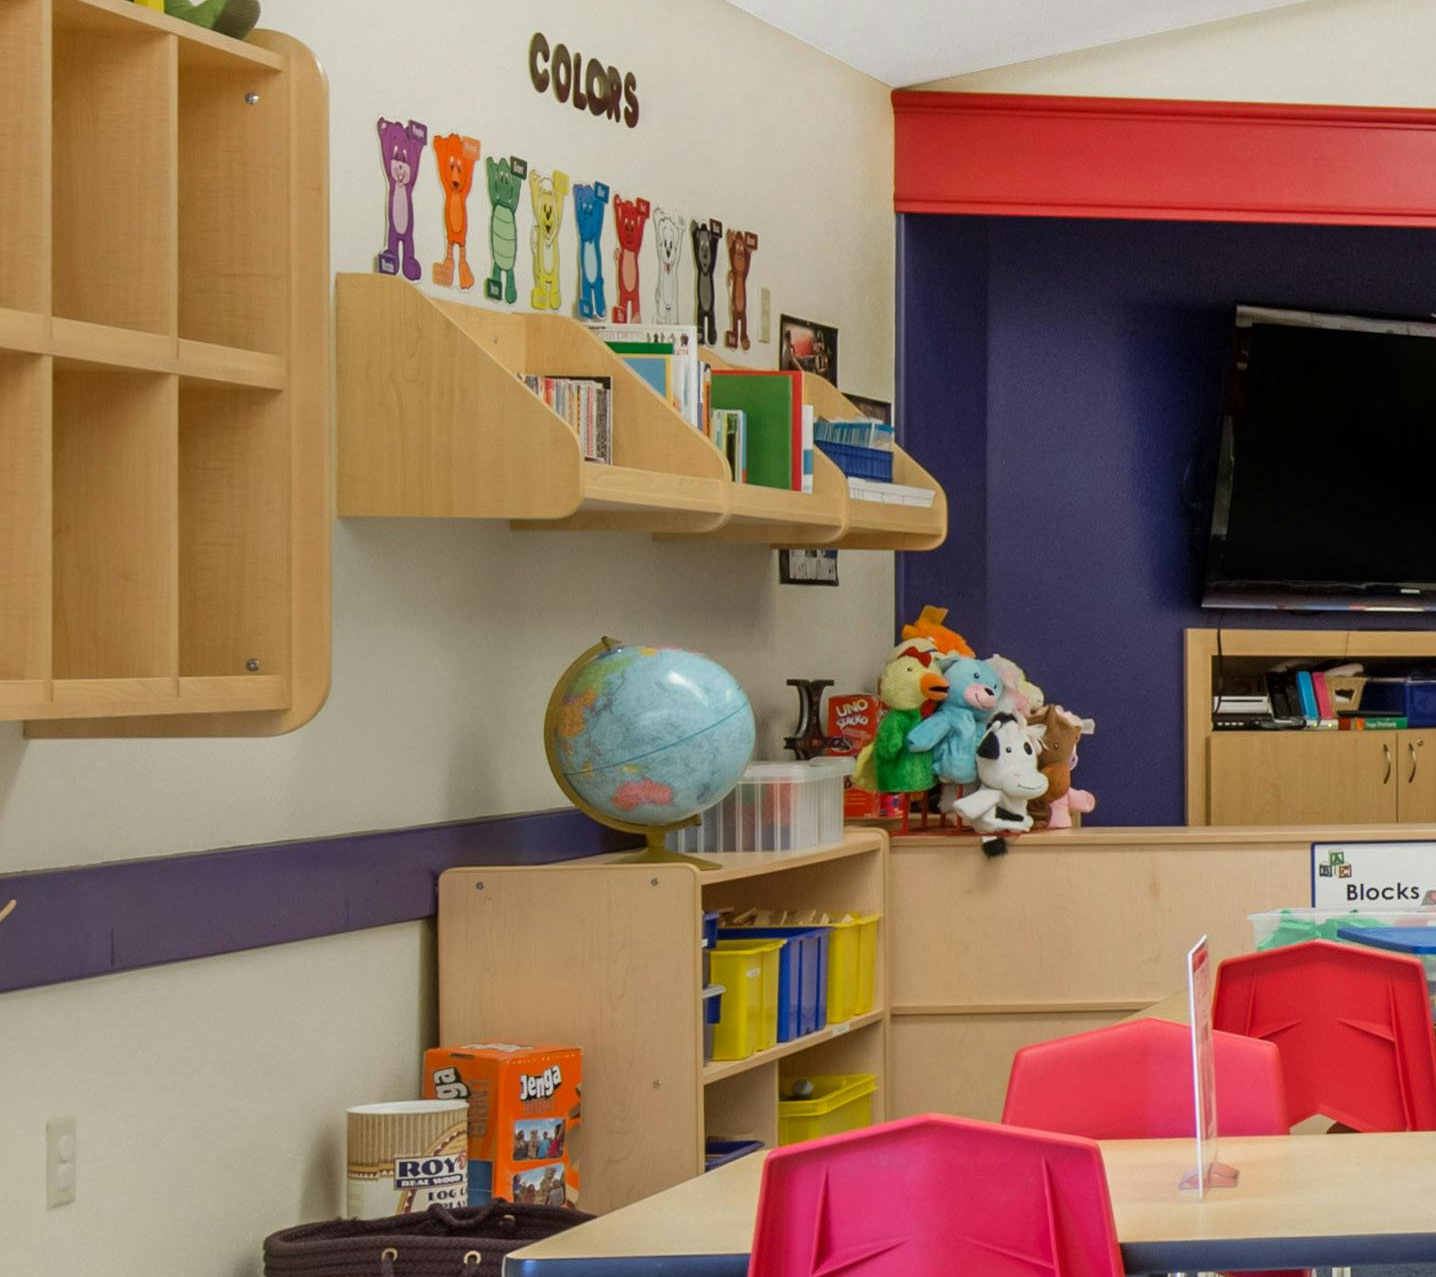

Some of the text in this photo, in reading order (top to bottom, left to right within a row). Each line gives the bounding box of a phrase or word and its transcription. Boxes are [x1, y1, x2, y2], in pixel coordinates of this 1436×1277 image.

[529, 32, 639, 128] COLORS
[836, 699, 868, 717] UNO
[1347, 882, 1420, 901] Blocks
[520, 1065, 561, 1101] Jenga
[399, 1159, 458, 1178] ROY
[428, 1190, 456, 1201] LOG
